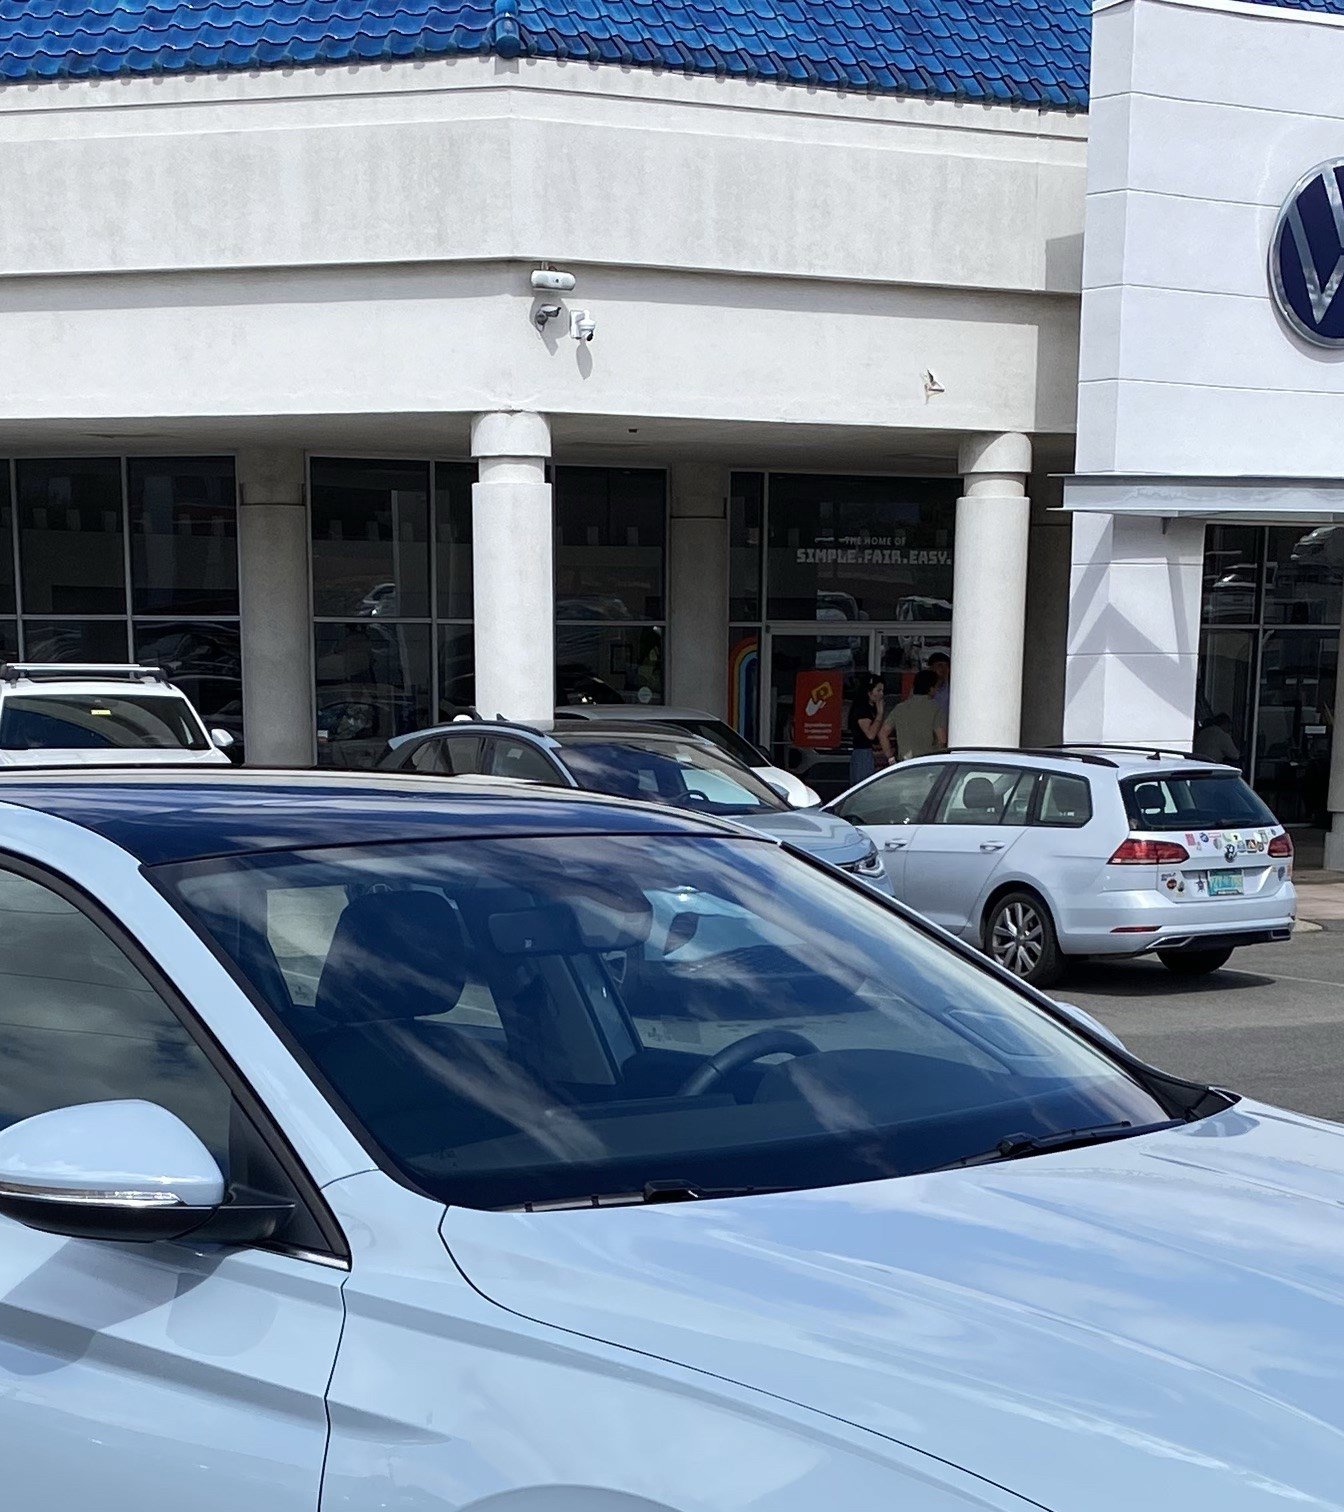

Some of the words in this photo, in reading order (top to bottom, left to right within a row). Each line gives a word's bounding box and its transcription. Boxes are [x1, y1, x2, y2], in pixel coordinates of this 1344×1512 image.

[844, 536, 862, 546] THE
[864, 536, 892, 546] HOME
[894, 537, 907, 546] OF
